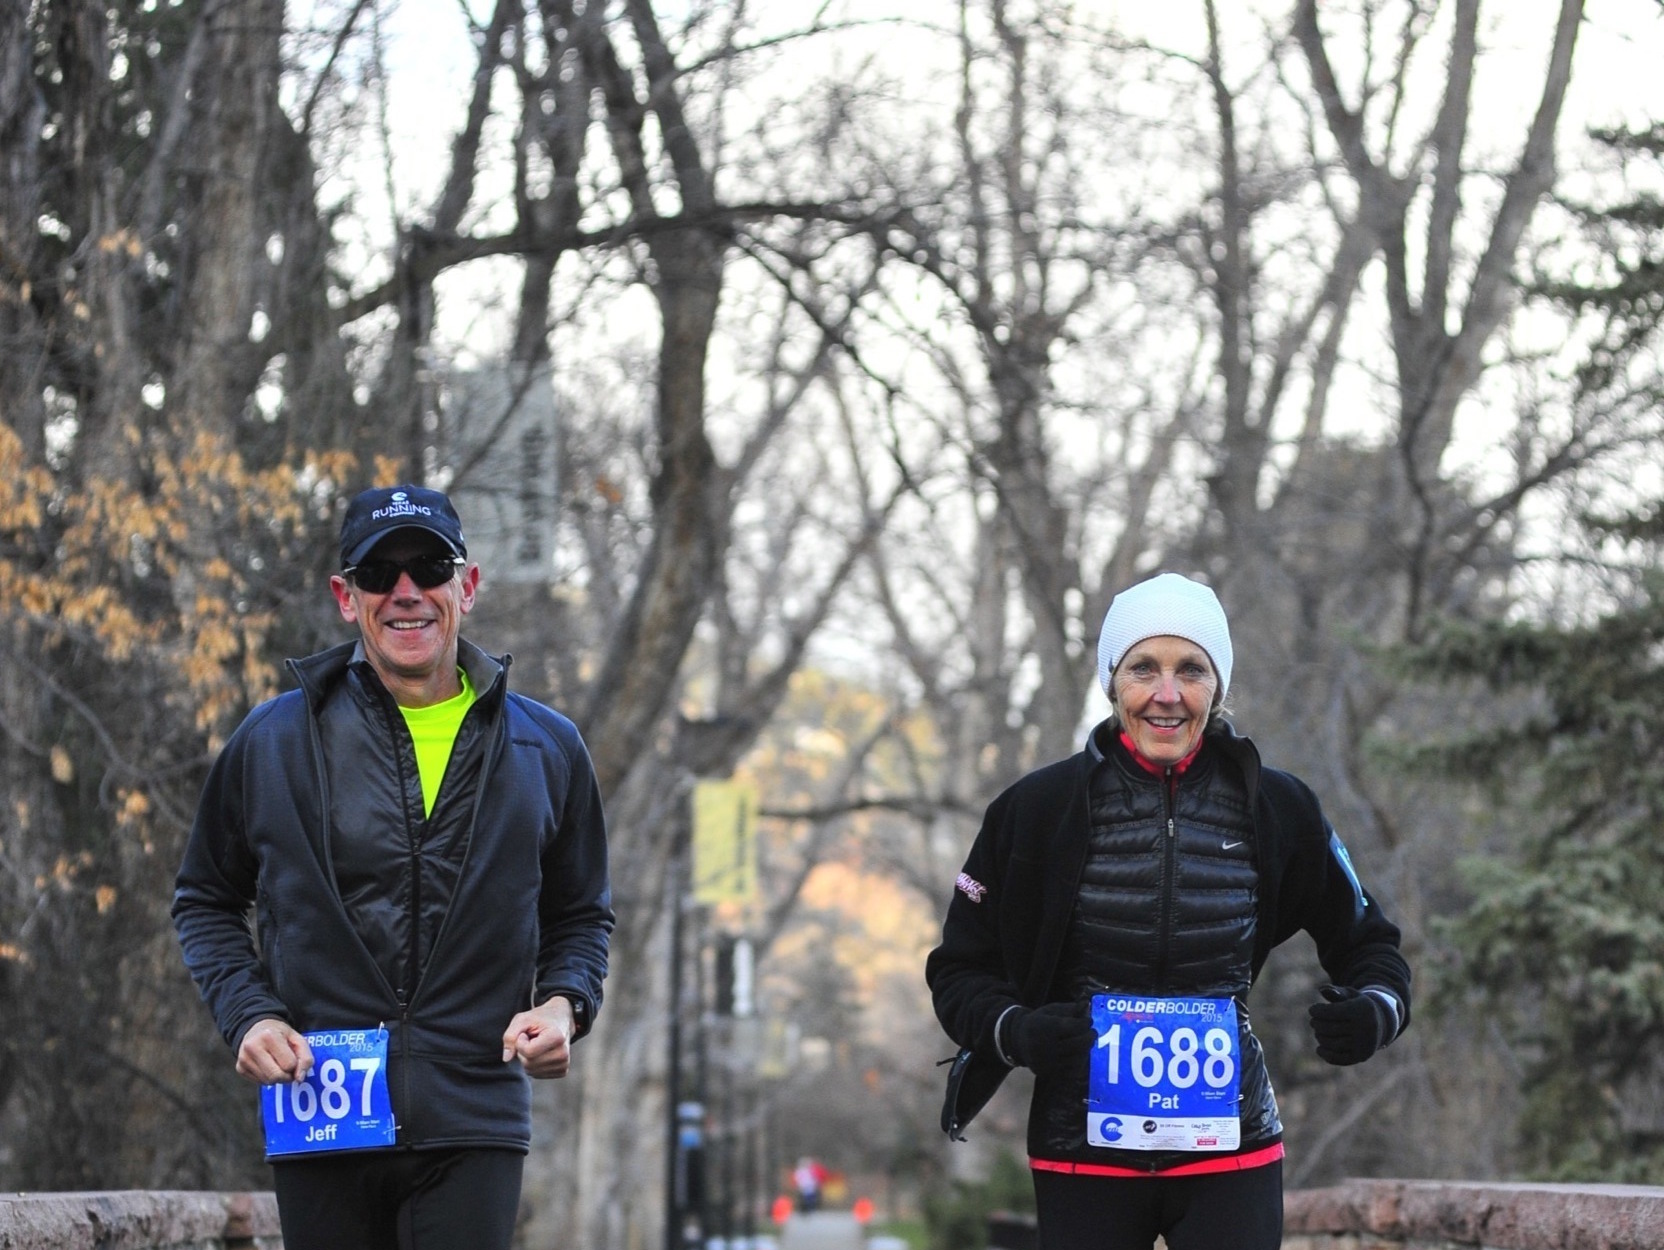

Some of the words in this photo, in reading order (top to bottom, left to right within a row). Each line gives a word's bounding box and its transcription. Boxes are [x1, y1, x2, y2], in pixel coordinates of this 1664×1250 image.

[372, 504, 431, 520] RUNNING
[1106, 999, 1216, 1015] COLDERBOLDER
[1201, 1013, 1223, 1023] 2015
[304, 1033, 366, 1047] RBOLDER
[350, 1042, 374, 1053] 2015
[1098, 1024, 1235, 1089] 1688
[267, 1057, 381, 1123] 1687
[1148, 1093, 1180, 1109] Pat
[305, 1124, 338, 1142] Jeff
